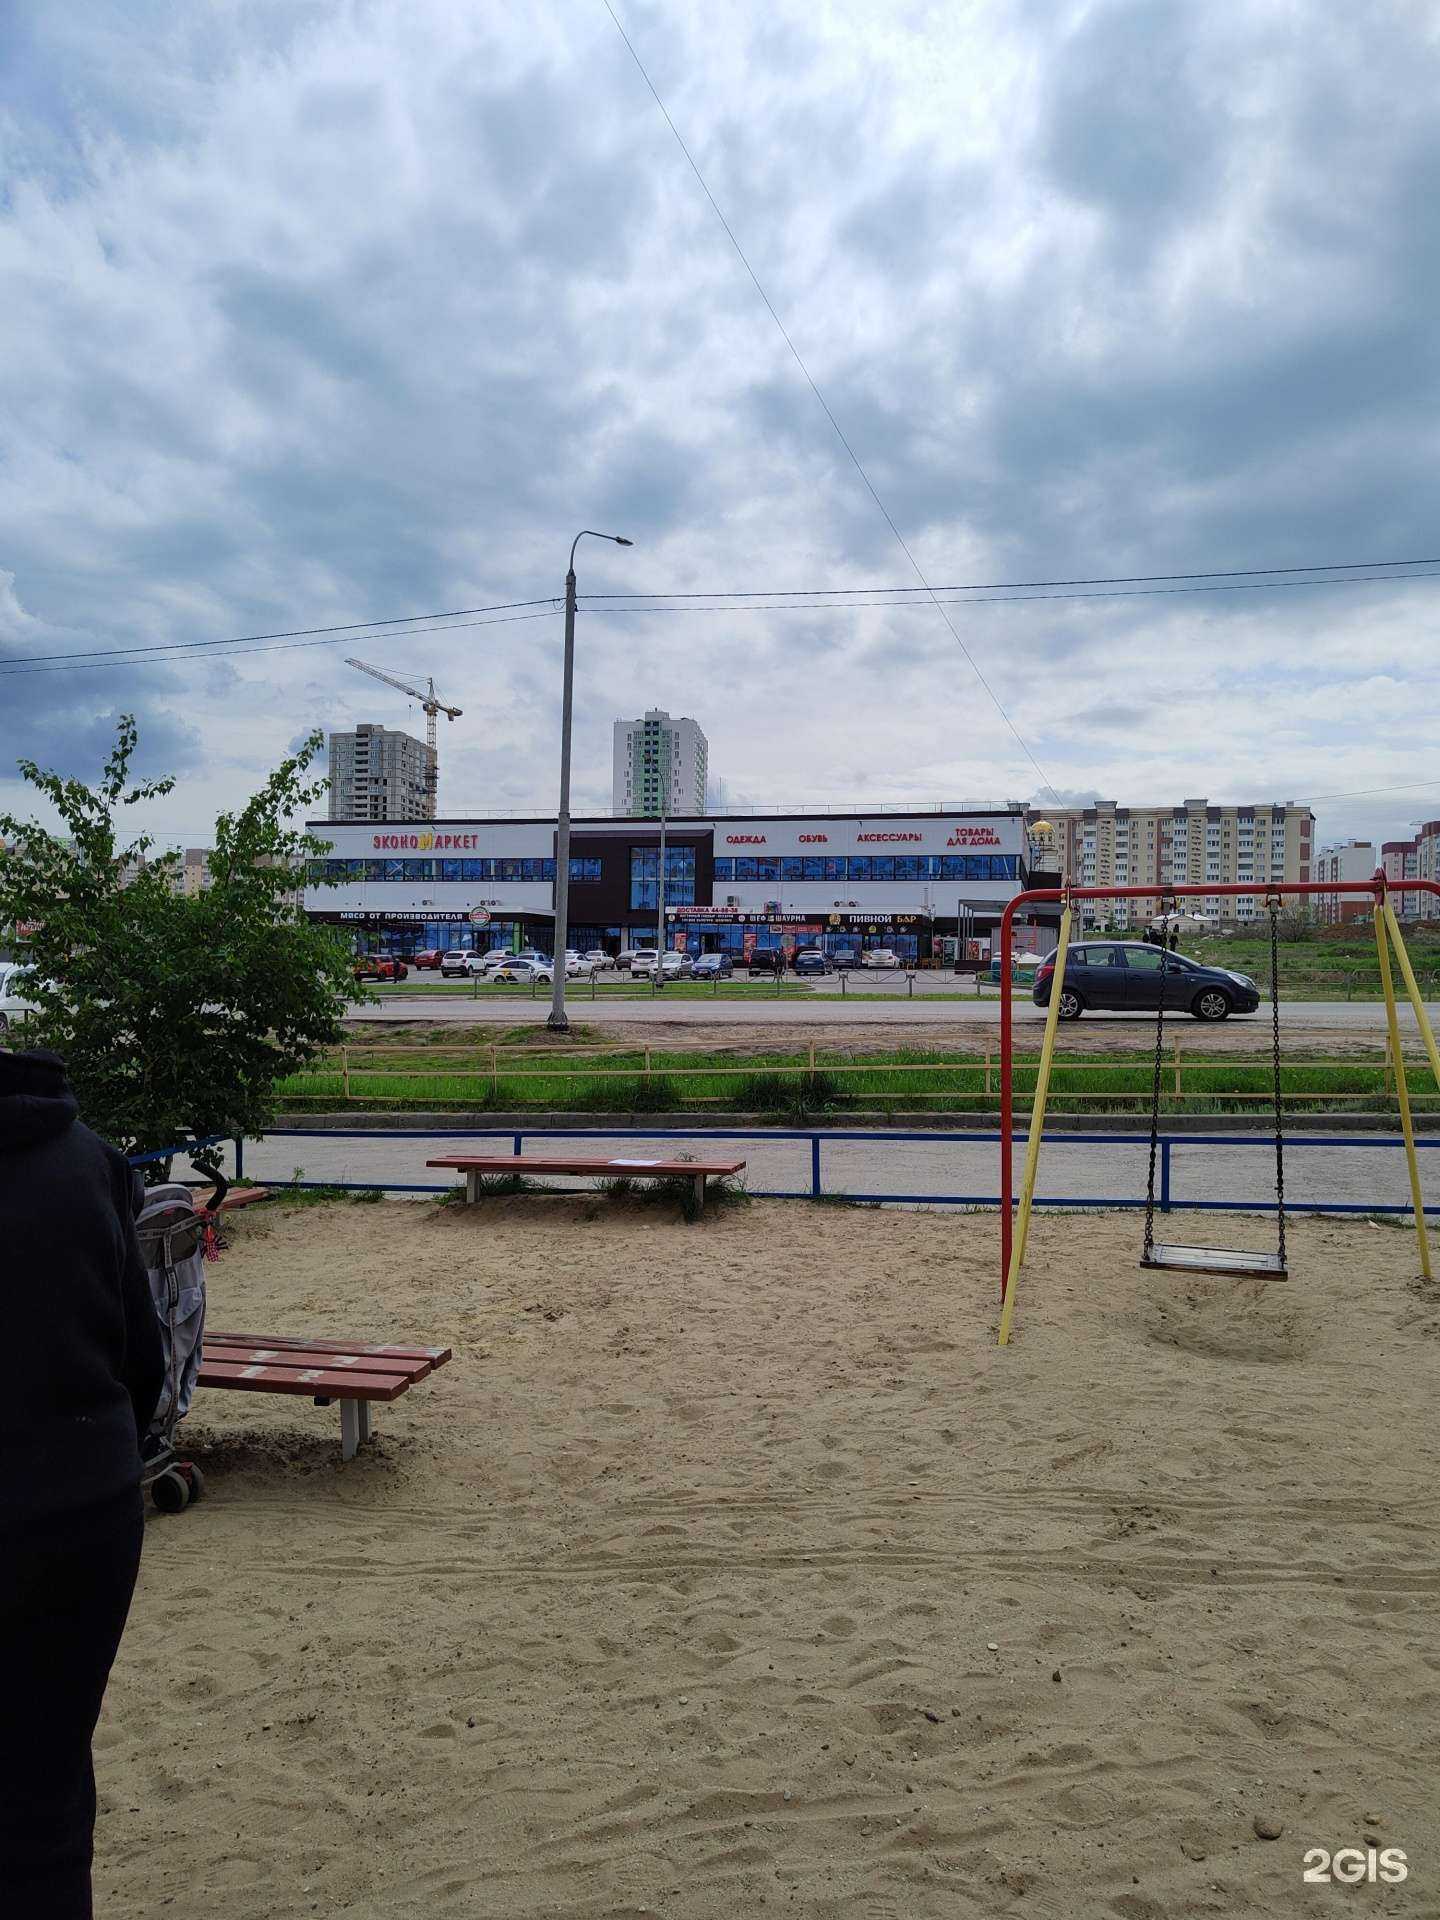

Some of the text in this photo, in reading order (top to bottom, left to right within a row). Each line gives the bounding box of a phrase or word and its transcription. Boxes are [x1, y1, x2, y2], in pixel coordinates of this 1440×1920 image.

[955, 827, 994, 836] ТОВАРЫ
[373, 832, 479, 850] ЭКОНОМАРКЕТ
[726, 835, 766, 844] ОДЕЖДА
[798, 834, 828, 843] ОБУВЬ
[857, 833, 922, 842] АКСЕССУАРЫ
[946, 837, 1001, 846] ДЛЯ ДОМА
[385, 912, 463, 920] ПРОИЗВОДИТЕЛЯ
[849, 914, 917, 924] ПИВНОЙ БАР
